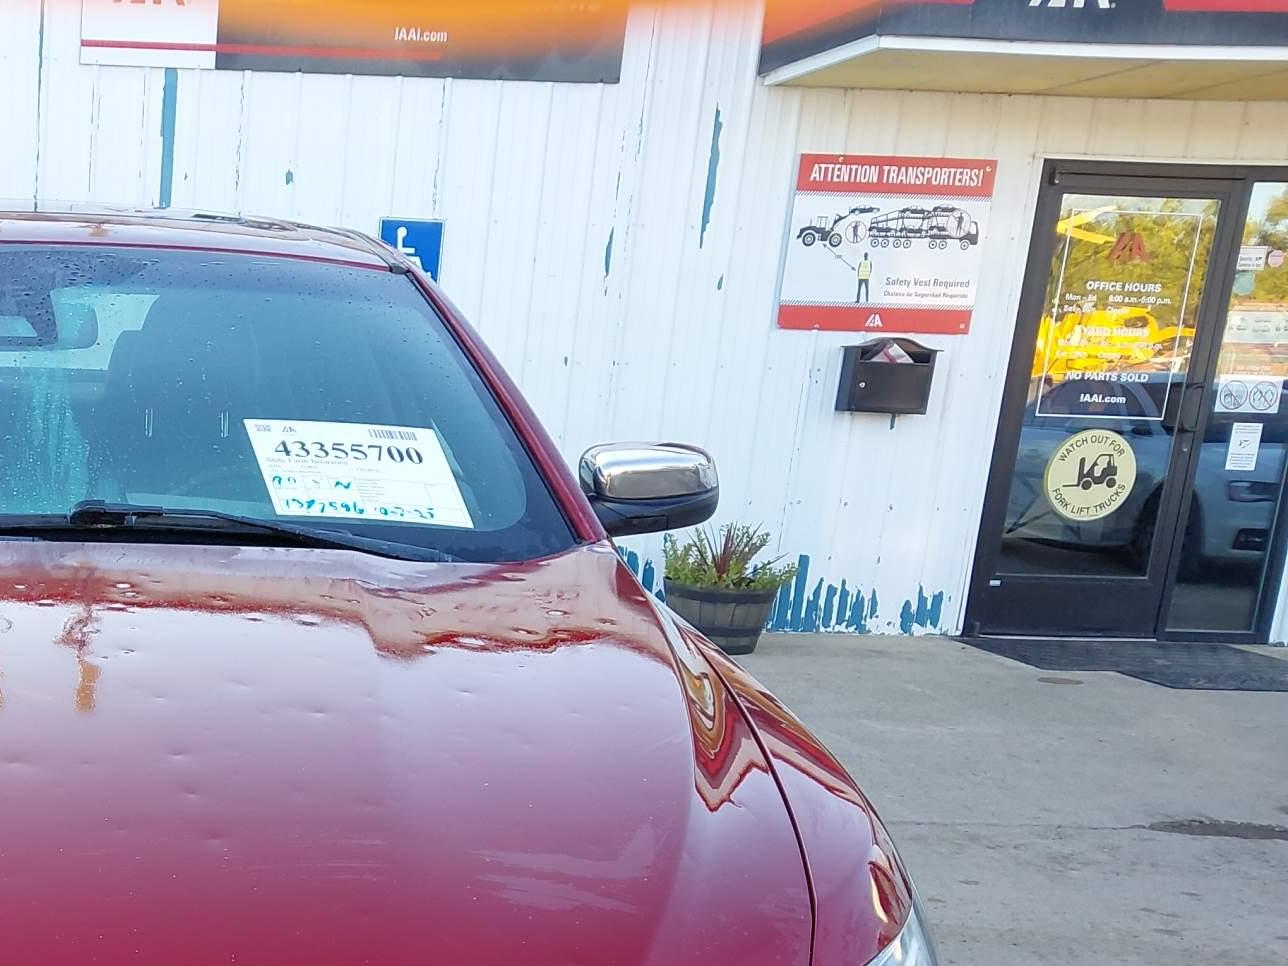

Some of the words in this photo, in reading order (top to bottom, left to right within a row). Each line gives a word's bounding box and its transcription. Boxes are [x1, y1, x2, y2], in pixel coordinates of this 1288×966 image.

[394, 27, 448, 42] IAAI.com
[810, 163, 880, 183] ATTENTION
[882, 165, 984, 187] TRANSPORTERS!
[885, 277, 911, 288] Safety
[913, 278, 931, 287] Vest
[933, 278, 970, 289] Required
[1086, 281, 1123, 292] OFFICE
[1124, 282, 1162, 293] HOURS
[1065, 293, 1082, 301] Mon
[1064, 372, 1081, 381] NO
[1083, 372, 1118, 382] PARTS
[1120, 373, 1149, 383] SOLD
[1079, 393, 1126, 404] IAAI.com
[274, 440, 424, 465] 43355700
[1058, 437, 1089, 462] WATCH
[1090, 434, 1110, 444] OUT
[1109, 439, 1126, 457] FOR
[1052, 487, 1071, 510] FORK
[1070, 504, 1091, 515] LIFT
[1093, 483, 1126, 513] TRUCKS
